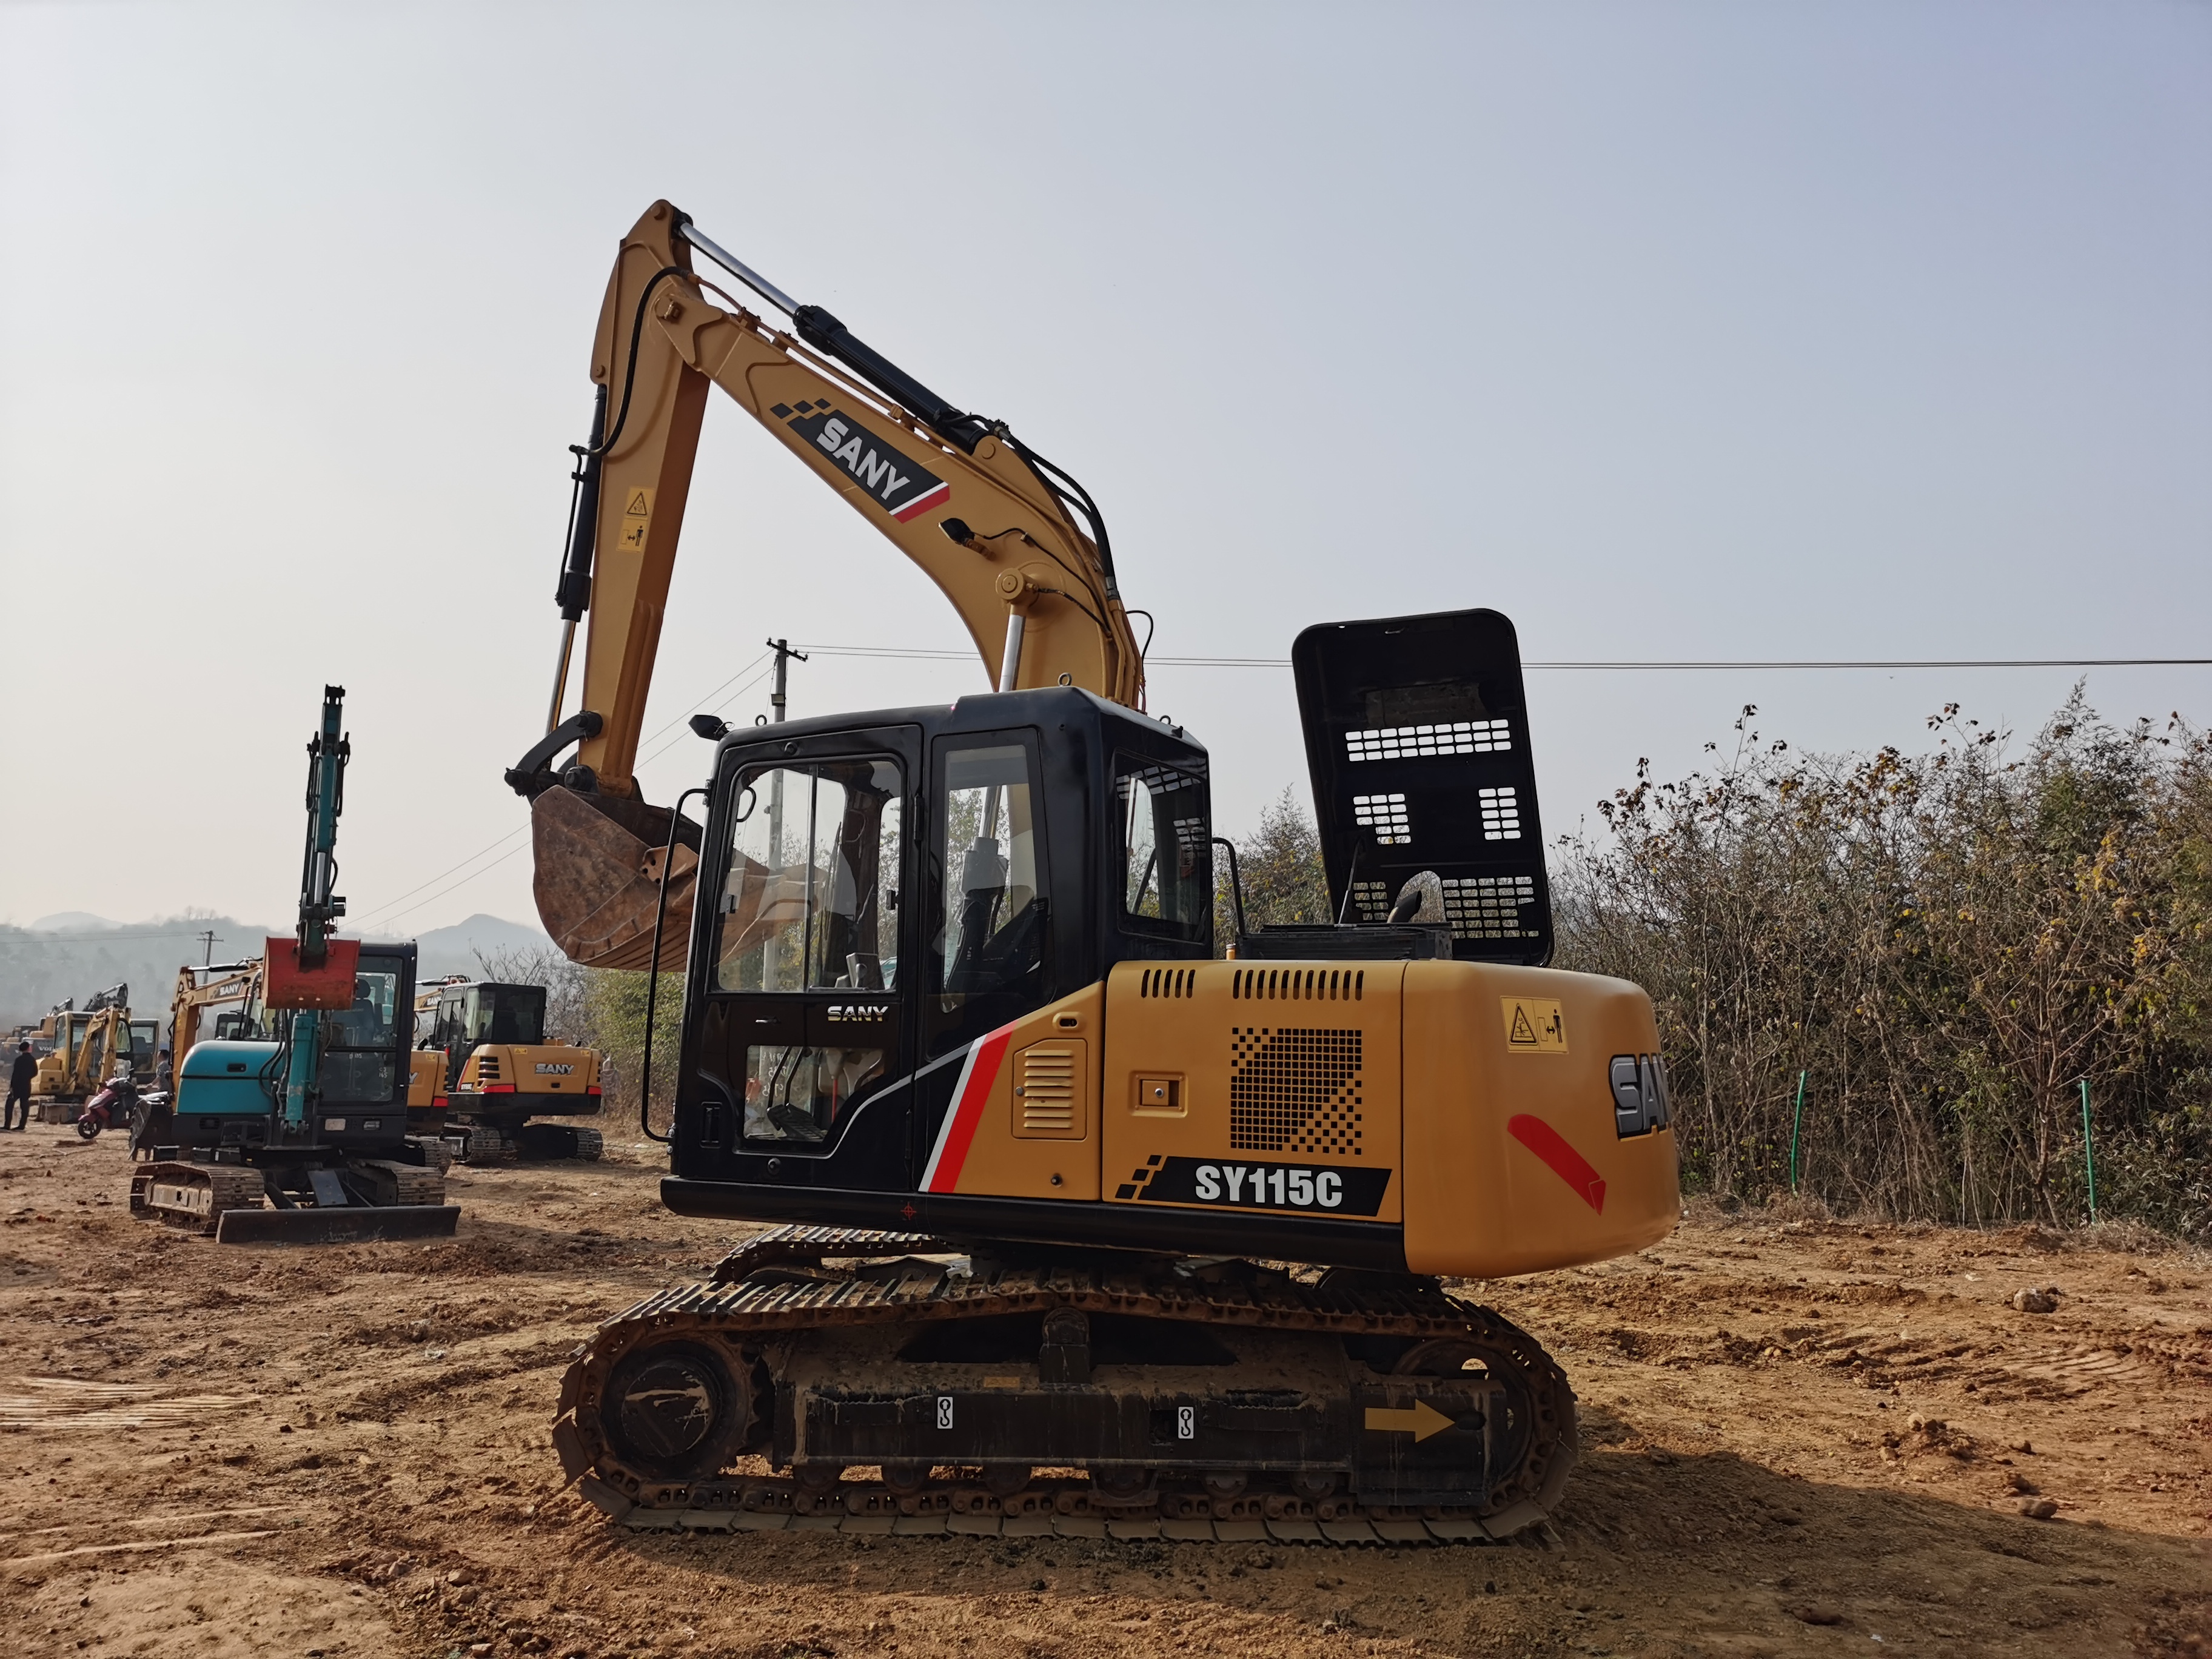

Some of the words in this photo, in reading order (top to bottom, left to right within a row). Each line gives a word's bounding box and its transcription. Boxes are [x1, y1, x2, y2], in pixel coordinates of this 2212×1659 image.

[816, 418, 910, 500] SANY
[220, 983, 240, 996] SANY
[827, 1005, 889, 1022] SANY
[535, 1063, 574, 1074] SANY
[1195, 1165, 1343, 1208] SY115C
